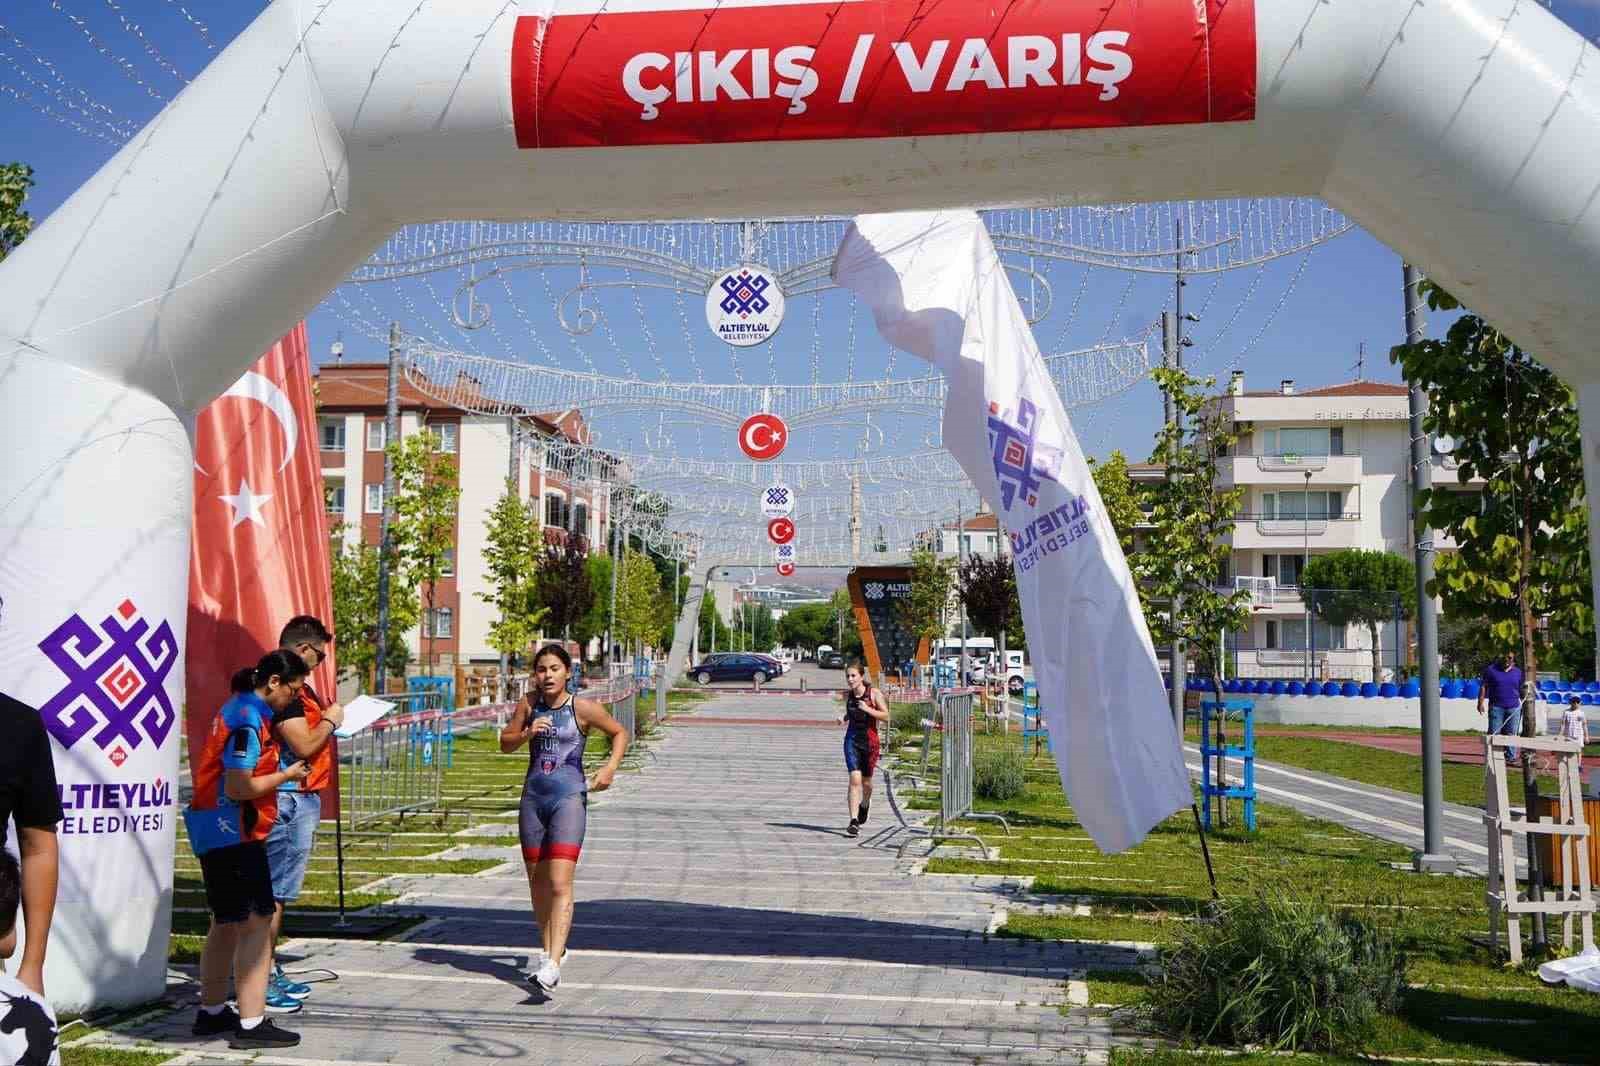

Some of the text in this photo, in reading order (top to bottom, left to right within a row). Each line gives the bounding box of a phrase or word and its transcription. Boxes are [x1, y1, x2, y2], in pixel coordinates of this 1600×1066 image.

[622, 30, 1134, 121] ÇIKIŞ / VARIŞ
[886, 583, 911, 592] ALTIE
[56, 778, 172, 809] LTIEYLÜL
[62, 814, 163, 834] ELEDIYESI
